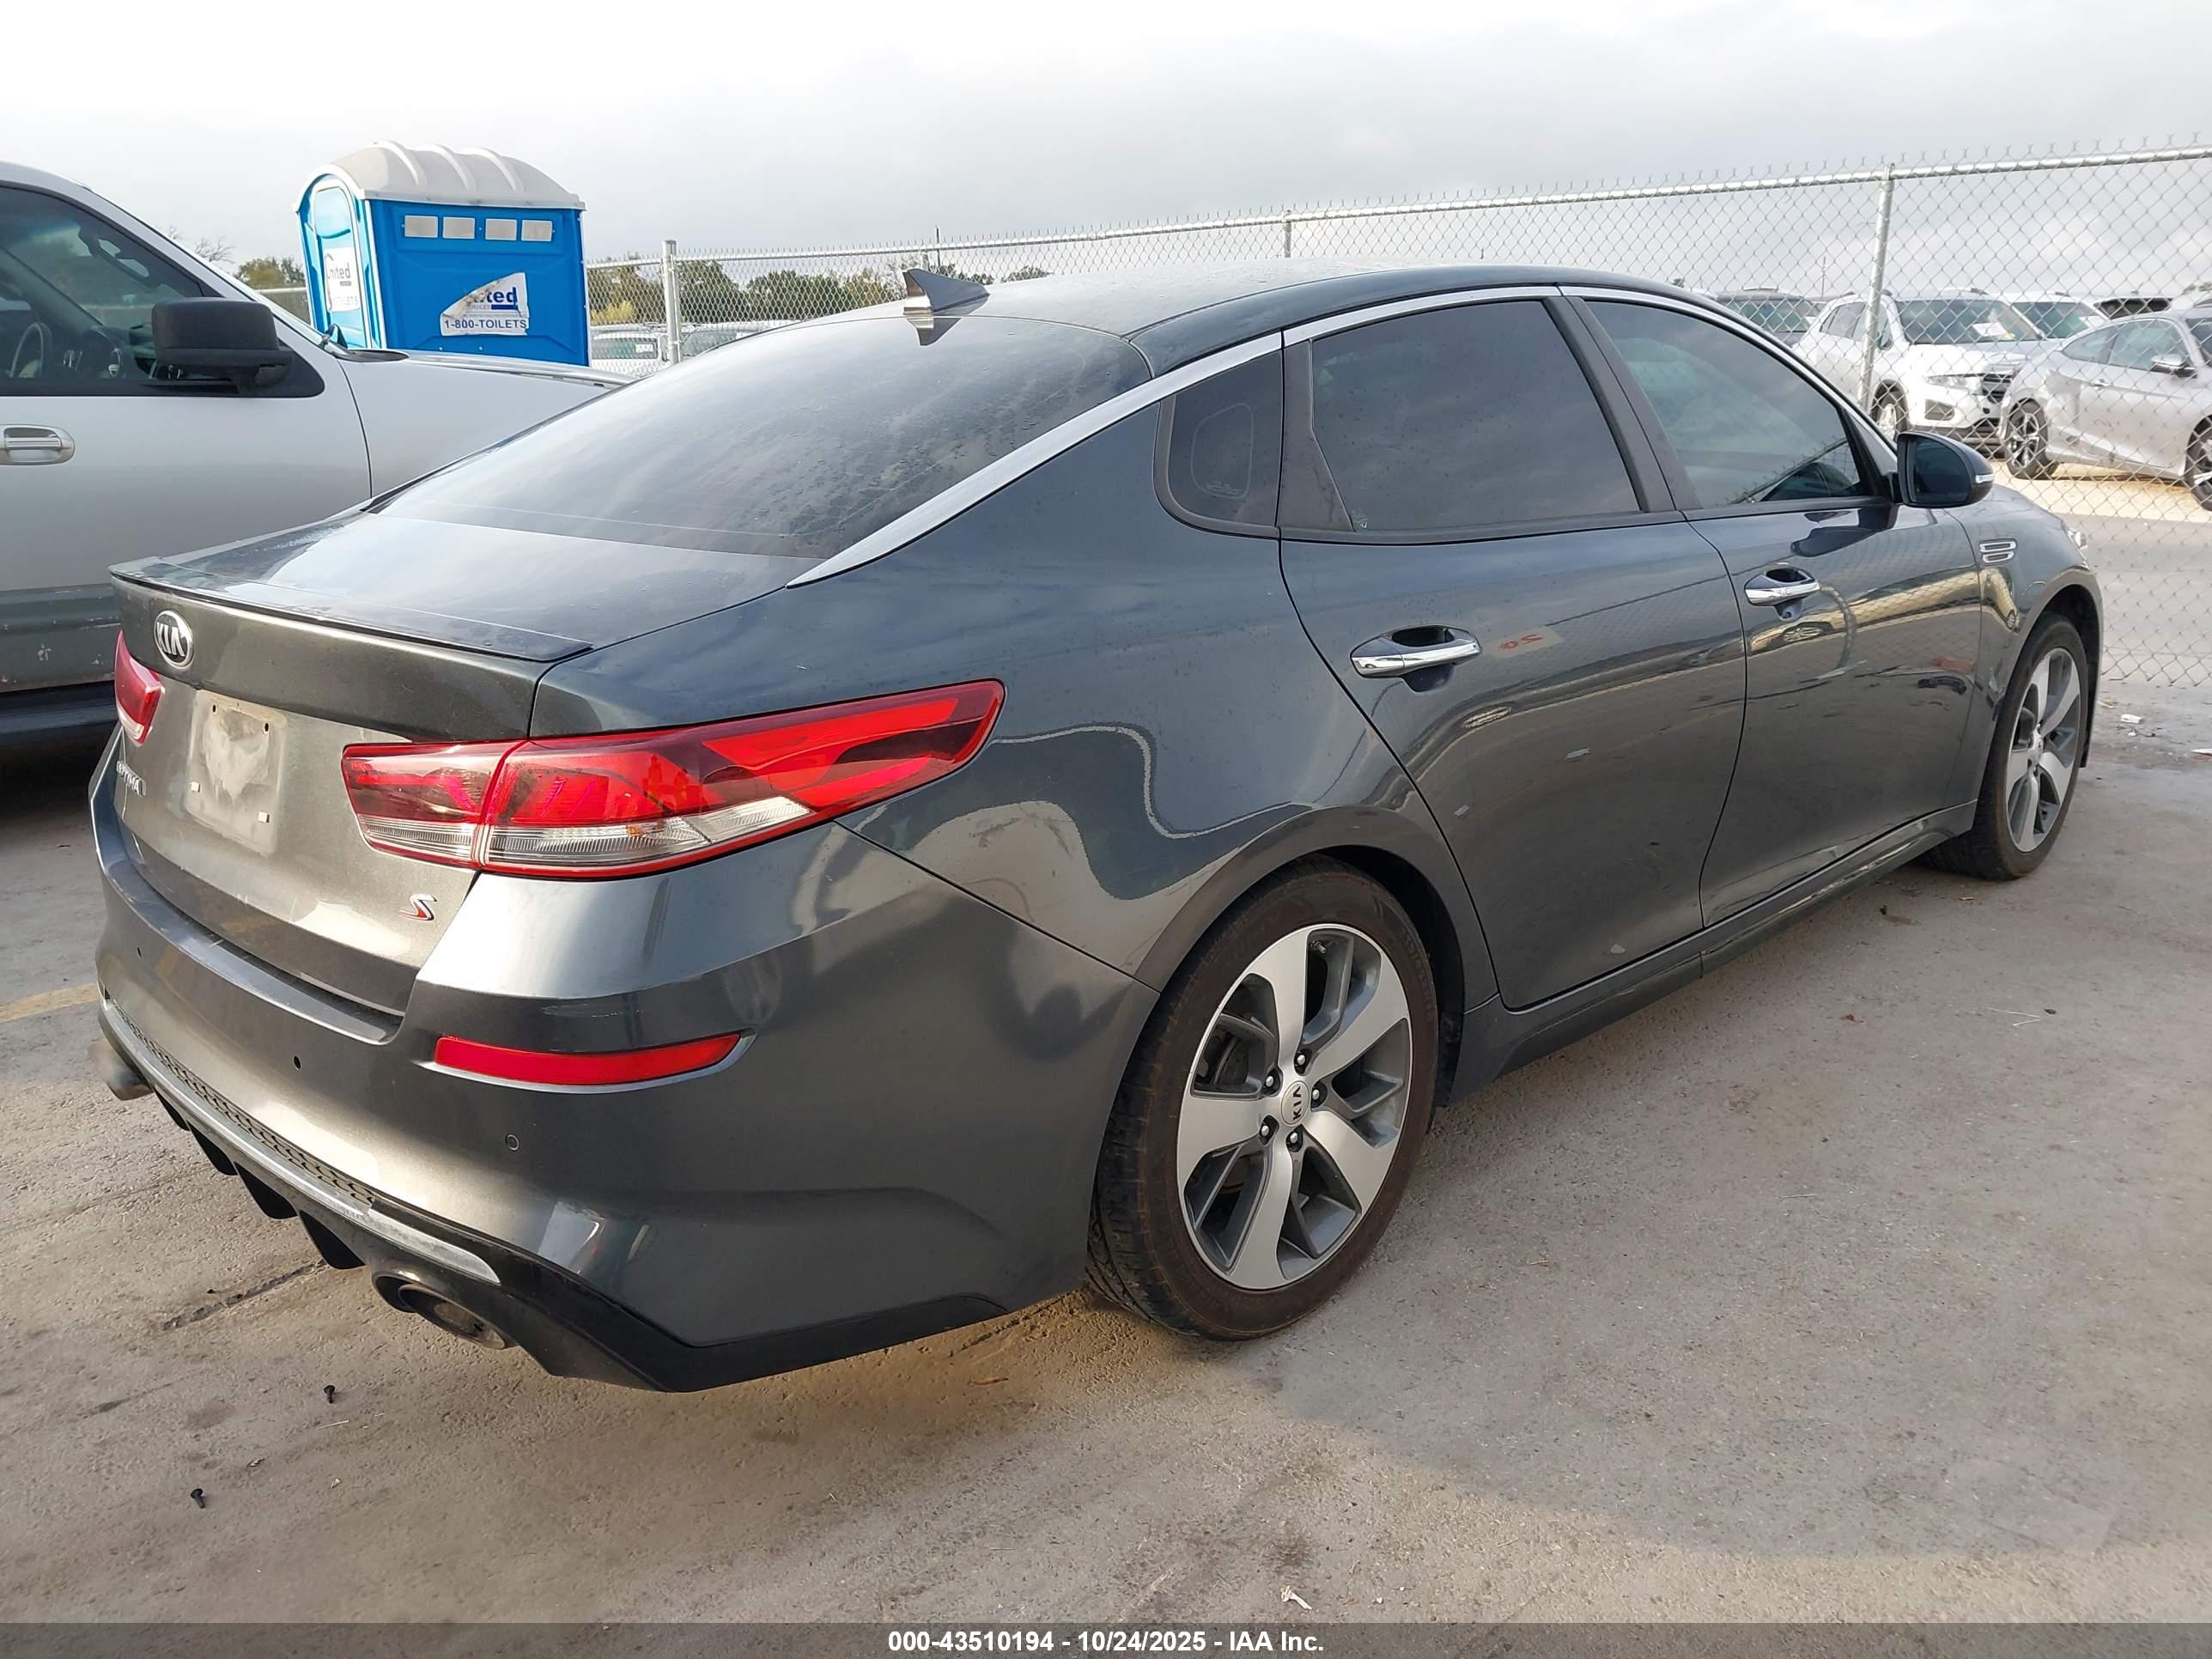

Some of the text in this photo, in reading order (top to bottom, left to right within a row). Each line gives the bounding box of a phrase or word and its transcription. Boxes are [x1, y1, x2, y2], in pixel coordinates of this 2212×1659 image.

[444, 318, 527, 329] 1-800-TOILETS
[156, 621, 185, 656] KIA
[398, 893, 438, 921] S
[1292, 1085, 1302, 1121] KIA
